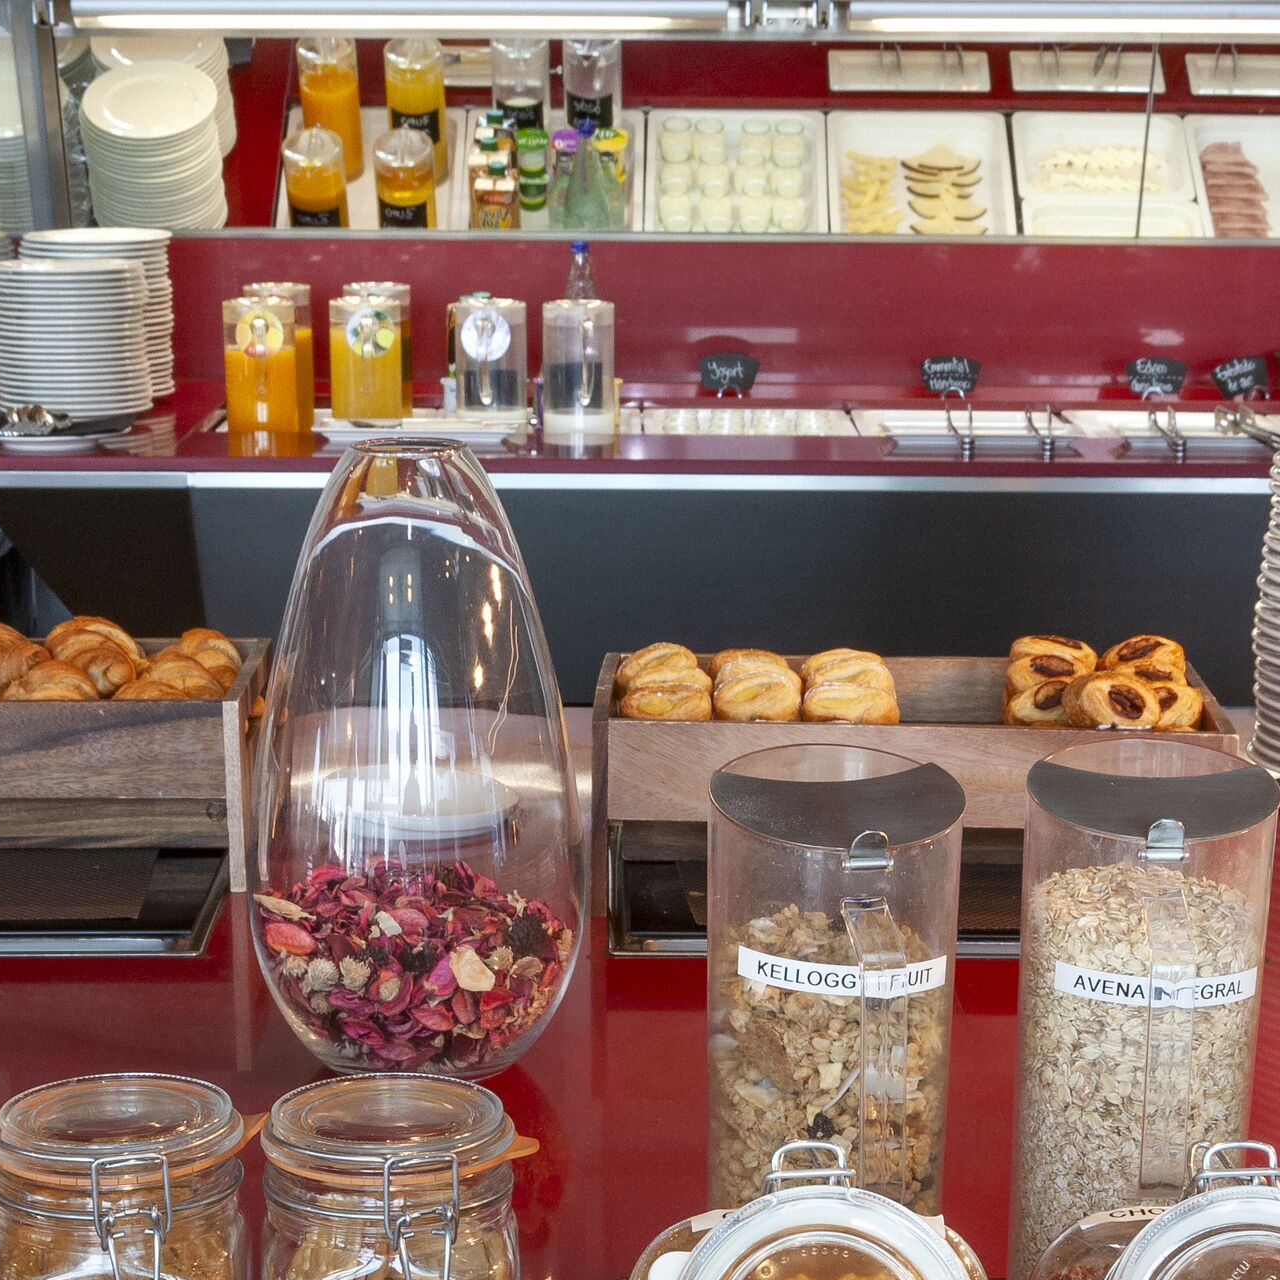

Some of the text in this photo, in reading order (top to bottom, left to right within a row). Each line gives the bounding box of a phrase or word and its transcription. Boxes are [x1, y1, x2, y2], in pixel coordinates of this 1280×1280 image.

[889, 967, 933, 992] FUIT
[1073, 974, 1244, 1001] AVENA NEGRAL
[1108, 1207, 1166, 1218] CHO
